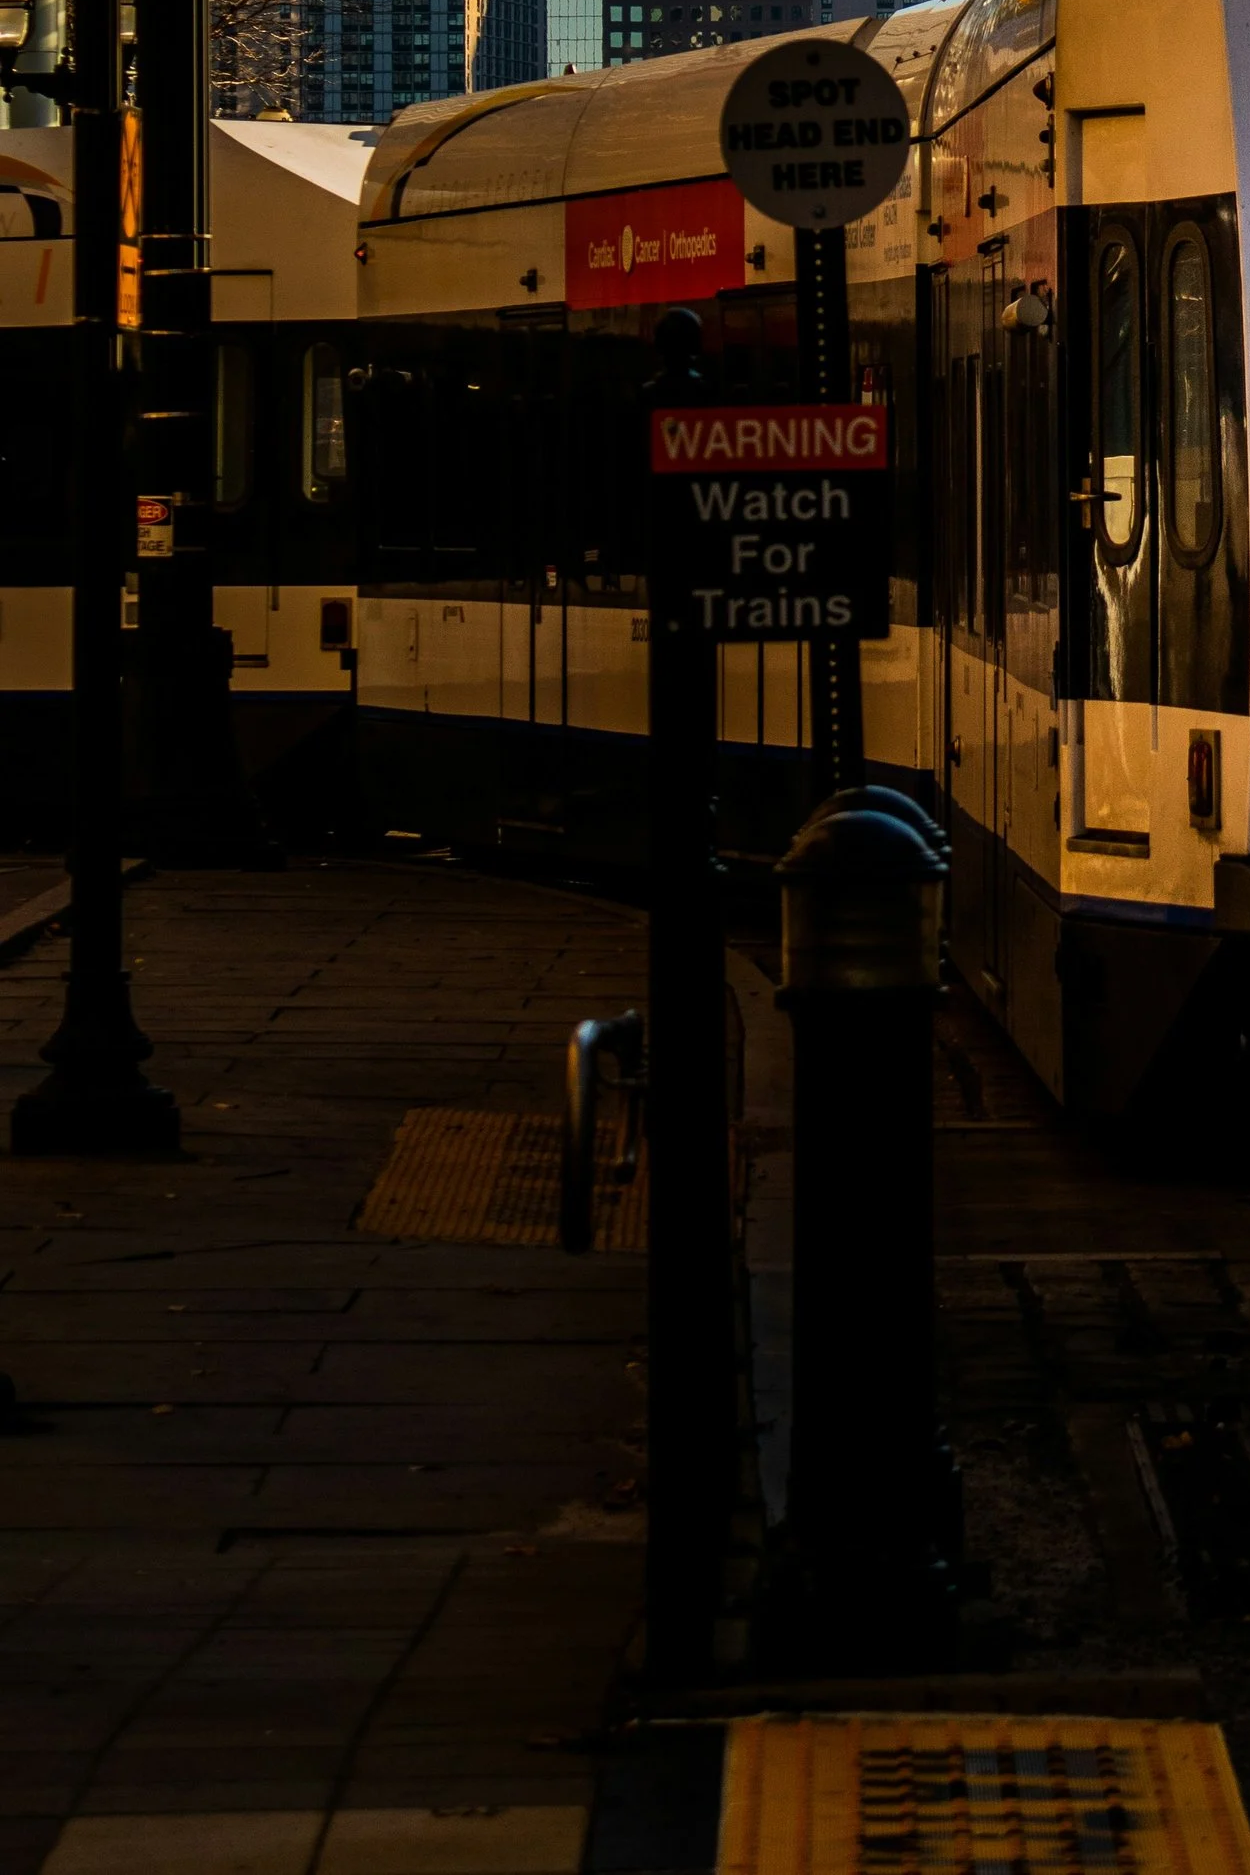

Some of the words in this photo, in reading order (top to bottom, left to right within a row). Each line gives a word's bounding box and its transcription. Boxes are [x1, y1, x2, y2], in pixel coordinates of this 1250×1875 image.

[769, 78, 860, 107] SPOT
[728, 122, 821, 150] HEAD
[833, 118, 903, 145] END
[773, 160, 864, 190] HERE
[588, 239, 616, 269] Cardiac
[635, 235, 660, 264] Cancer
[669, 226, 717, 265] Orthopedics
[660, 415, 879, 460] WARNING
[689, 478, 851, 522] Watch
[730, 533, 816, 575] For
[691, 586, 853, 629] Trains
